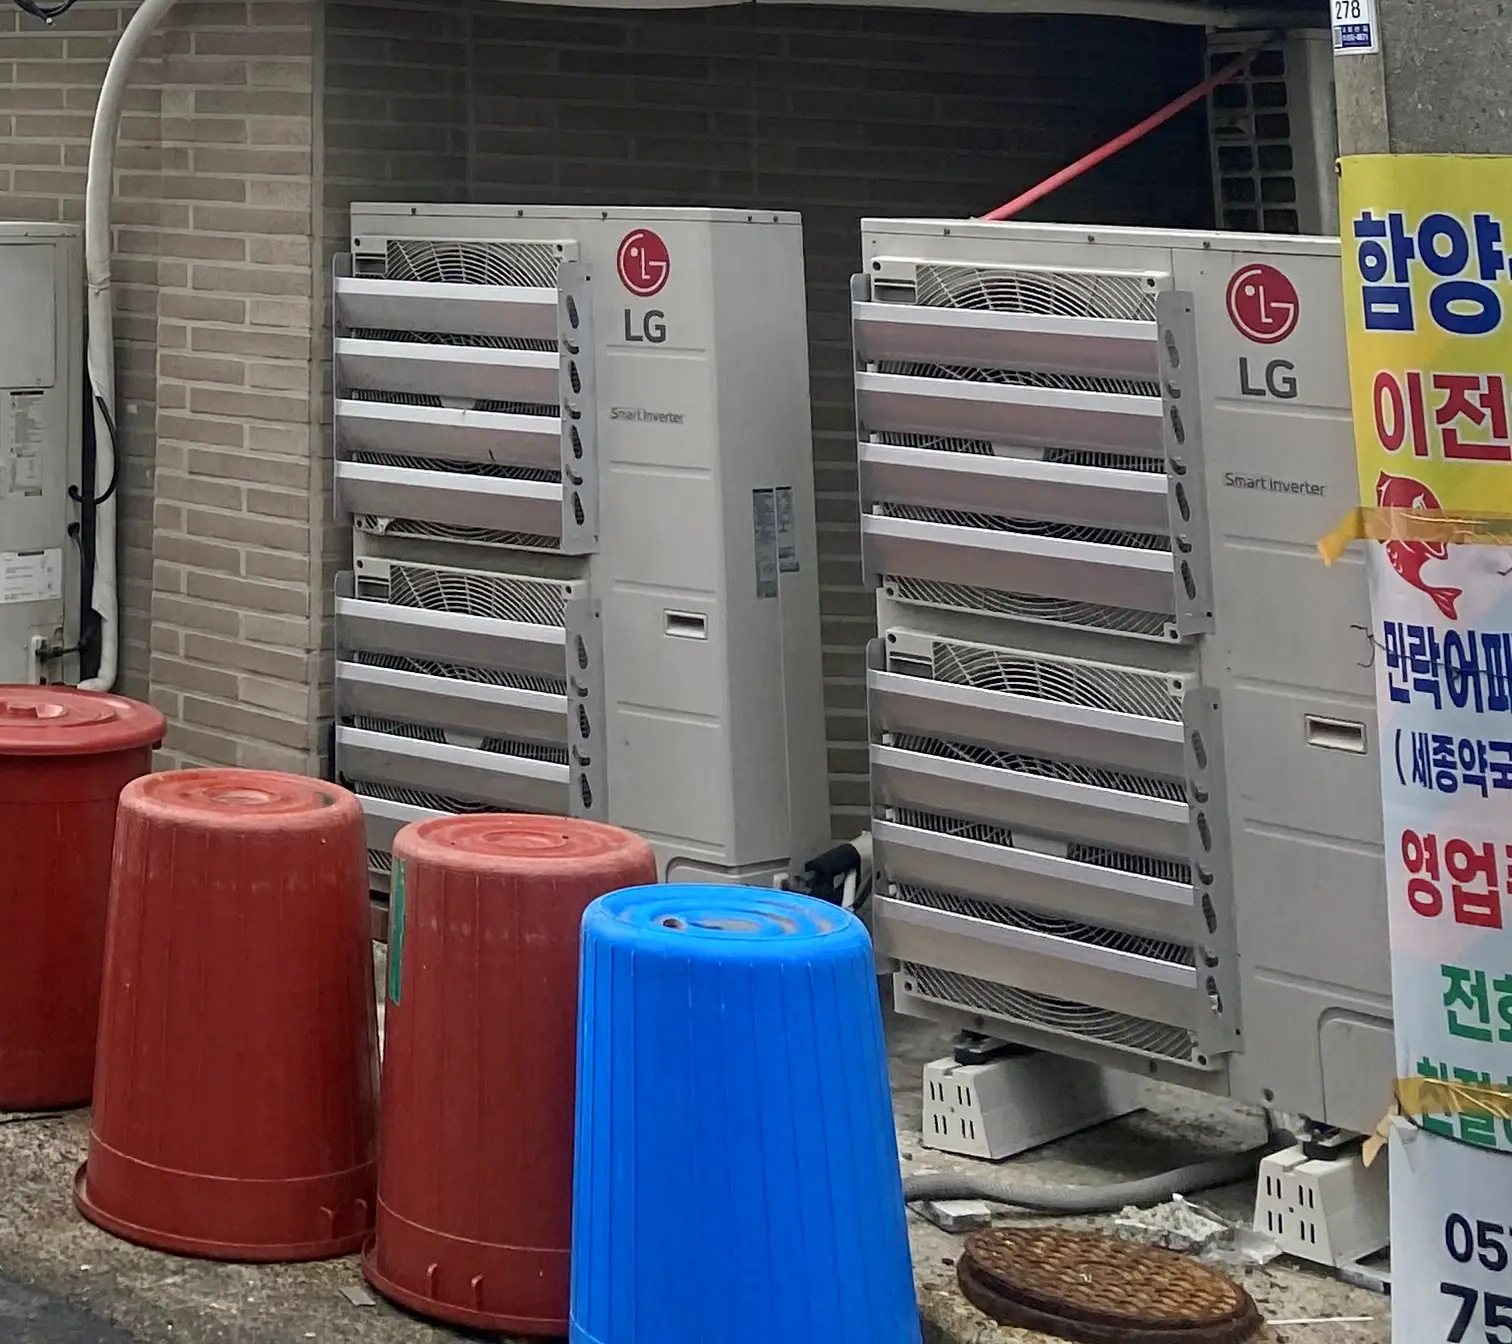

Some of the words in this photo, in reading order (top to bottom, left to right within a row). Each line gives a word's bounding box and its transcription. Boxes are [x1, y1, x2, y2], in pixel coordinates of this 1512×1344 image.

[1335, 0, 1361, 20] 278
[1353, 211, 1512, 335] 함양
[624, 308, 667, 343] LG
[1239, 357, 1298, 399] LG
[611, 407, 643, 420] Smart
[1373, 370, 1512, 462] 이전
[1225, 472, 1267, 489] Smart
[1402, 829, 1512, 930] 영업
[1445, 1213, 1512, 1272] 05
